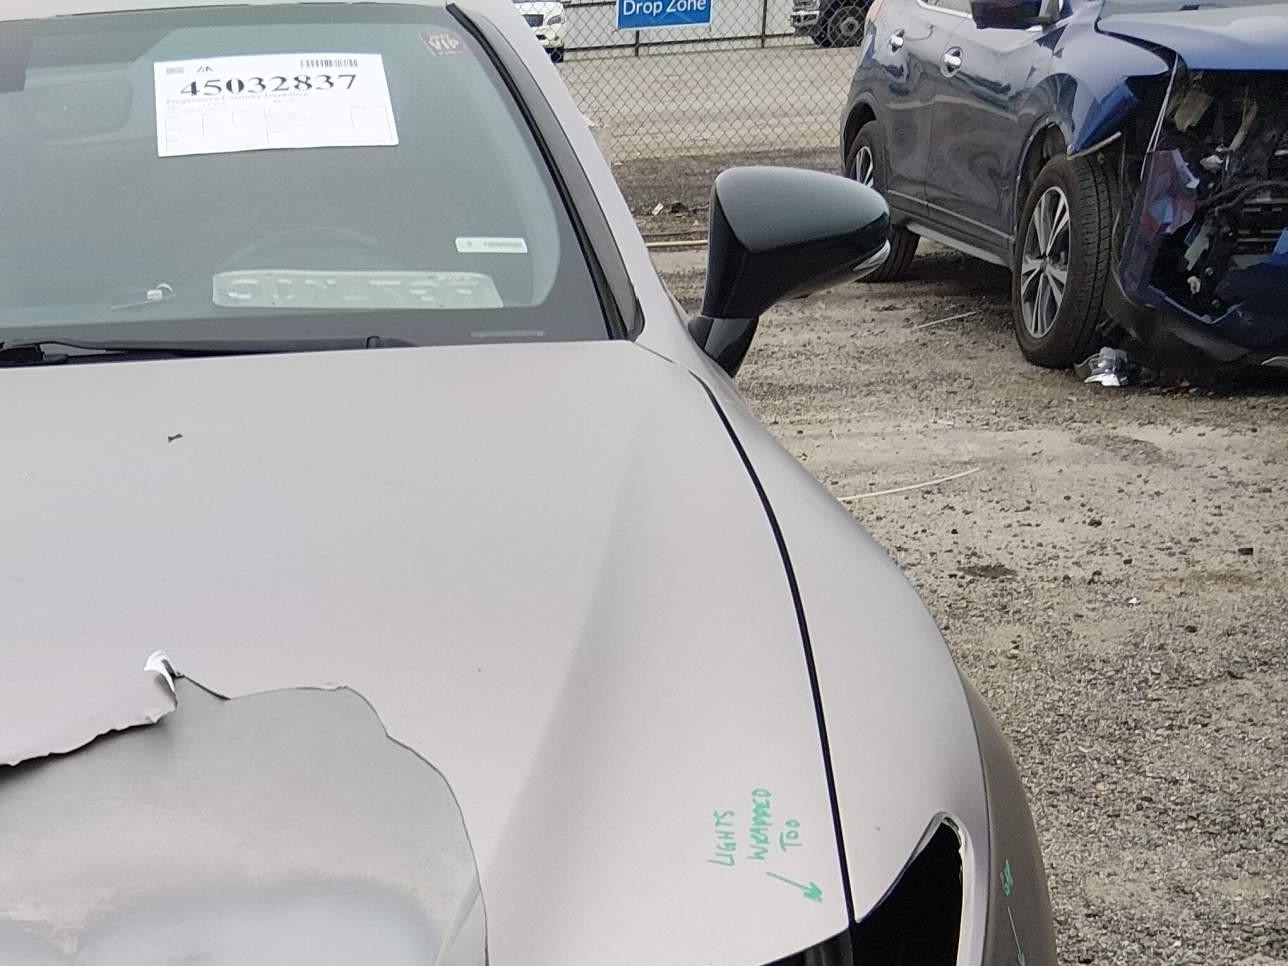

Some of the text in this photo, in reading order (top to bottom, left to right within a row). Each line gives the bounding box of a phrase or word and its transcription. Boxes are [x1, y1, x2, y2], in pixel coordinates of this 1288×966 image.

[623, 0, 706, 16] Drop Zone
[179, 74, 357, 96] 45032837
[708, 810, 735, 867] LIGHTS
[779, 818, 803, 852] TOO
